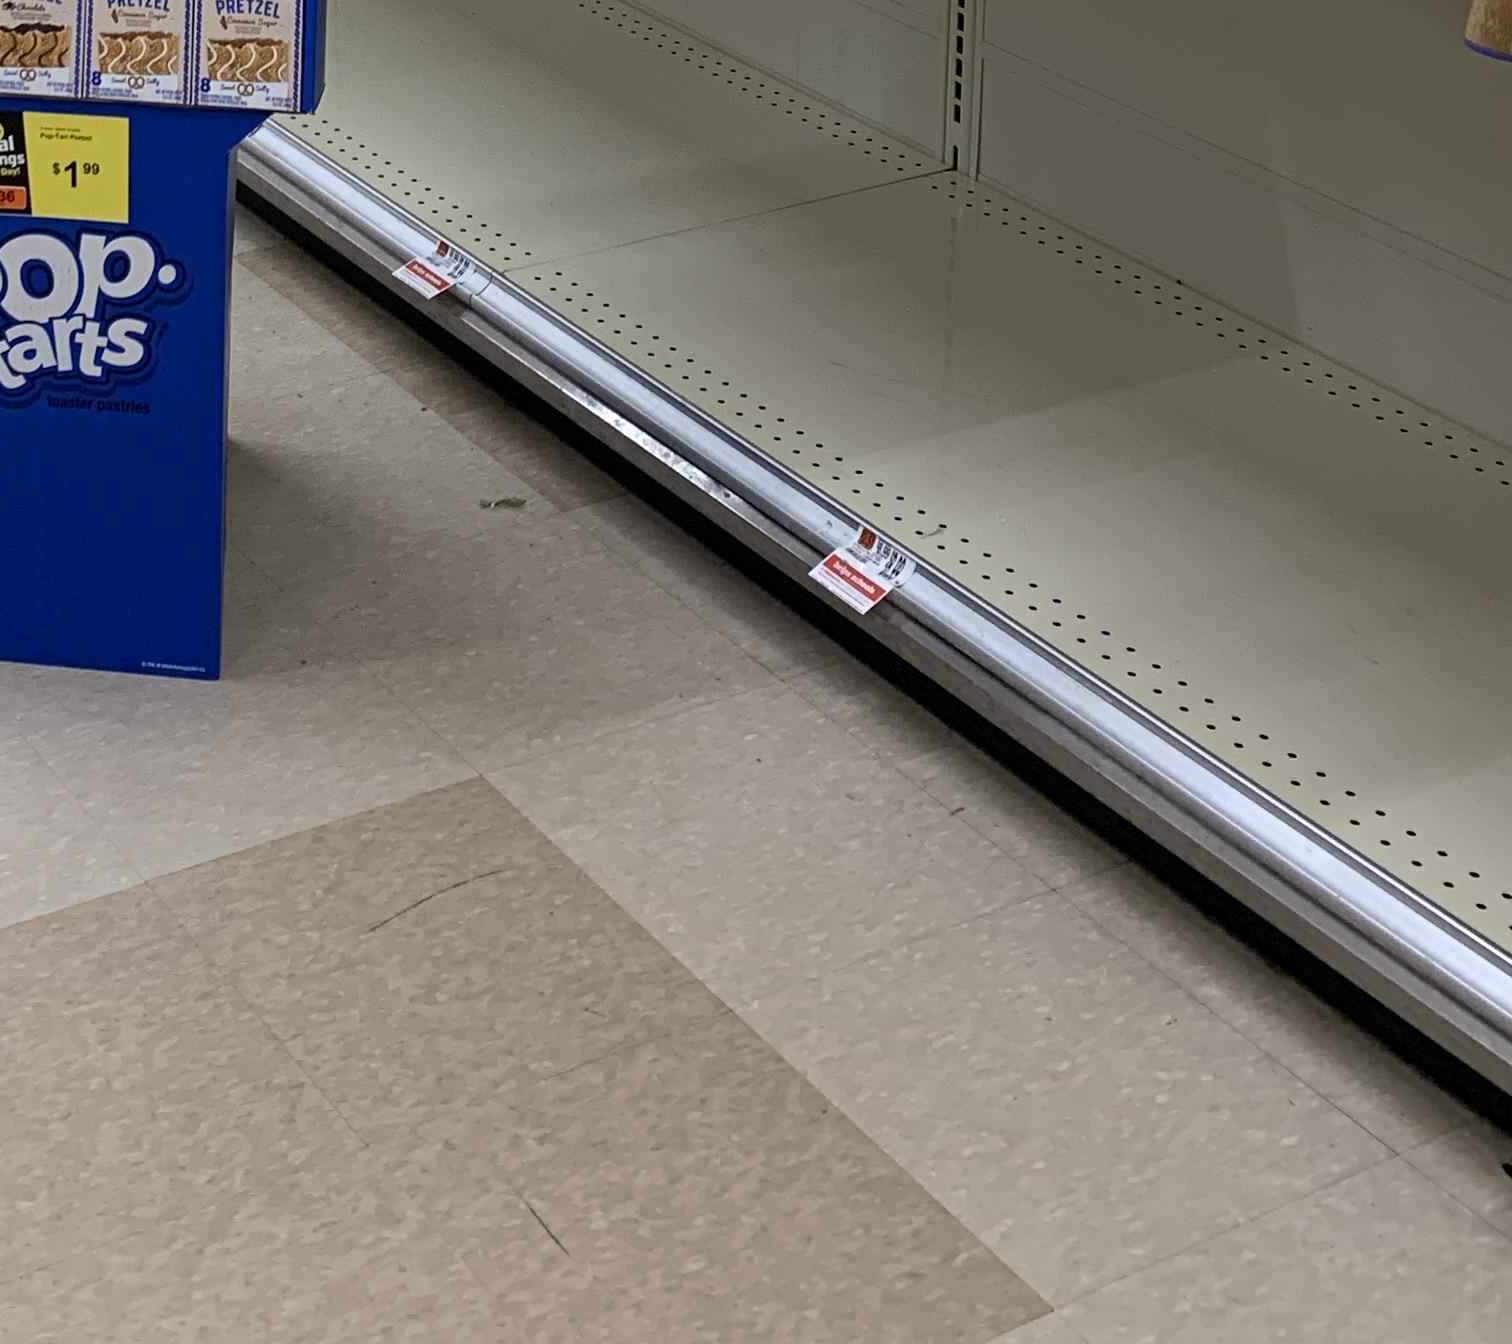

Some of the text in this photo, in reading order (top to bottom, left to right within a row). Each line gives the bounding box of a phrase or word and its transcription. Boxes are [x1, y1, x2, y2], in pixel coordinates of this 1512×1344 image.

[92, 72, 102, 85] 8
[201, 78, 211, 92] 8
[47, 397, 150, 414] toaster pastries
